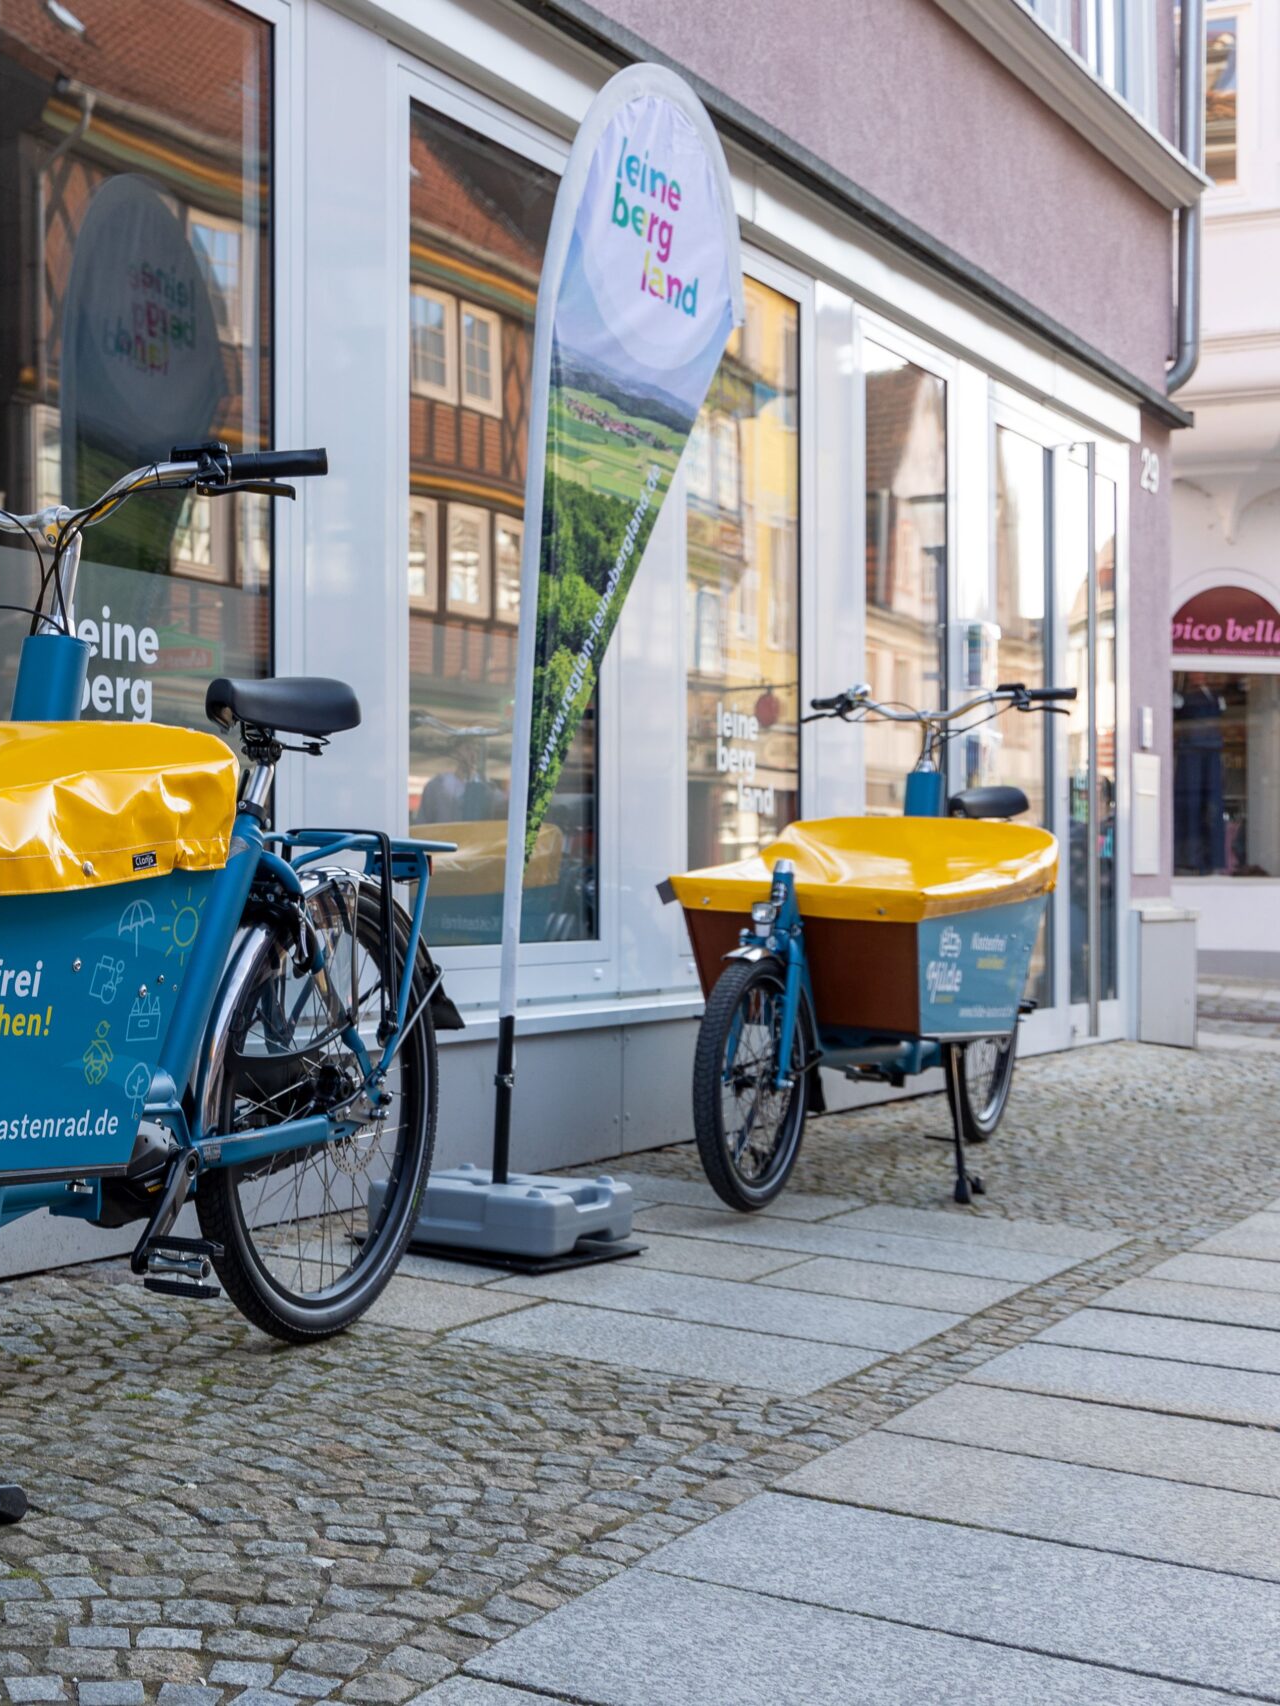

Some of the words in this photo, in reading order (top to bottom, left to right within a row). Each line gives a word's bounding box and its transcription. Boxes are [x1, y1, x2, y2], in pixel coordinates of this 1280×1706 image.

[616, 136, 682, 212] leine
[612, 181, 674, 263] berg
[640, 250, 700, 318] land
[70, 604, 160, 664] eine
[538, 464, 661, 773] www.region-leinebergland.de
[716, 701, 759, 741] leine
[716, 736, 756, 782] berg
[737, 779, 774, 816] land
[926, 961, 963, 1004] Hilde
